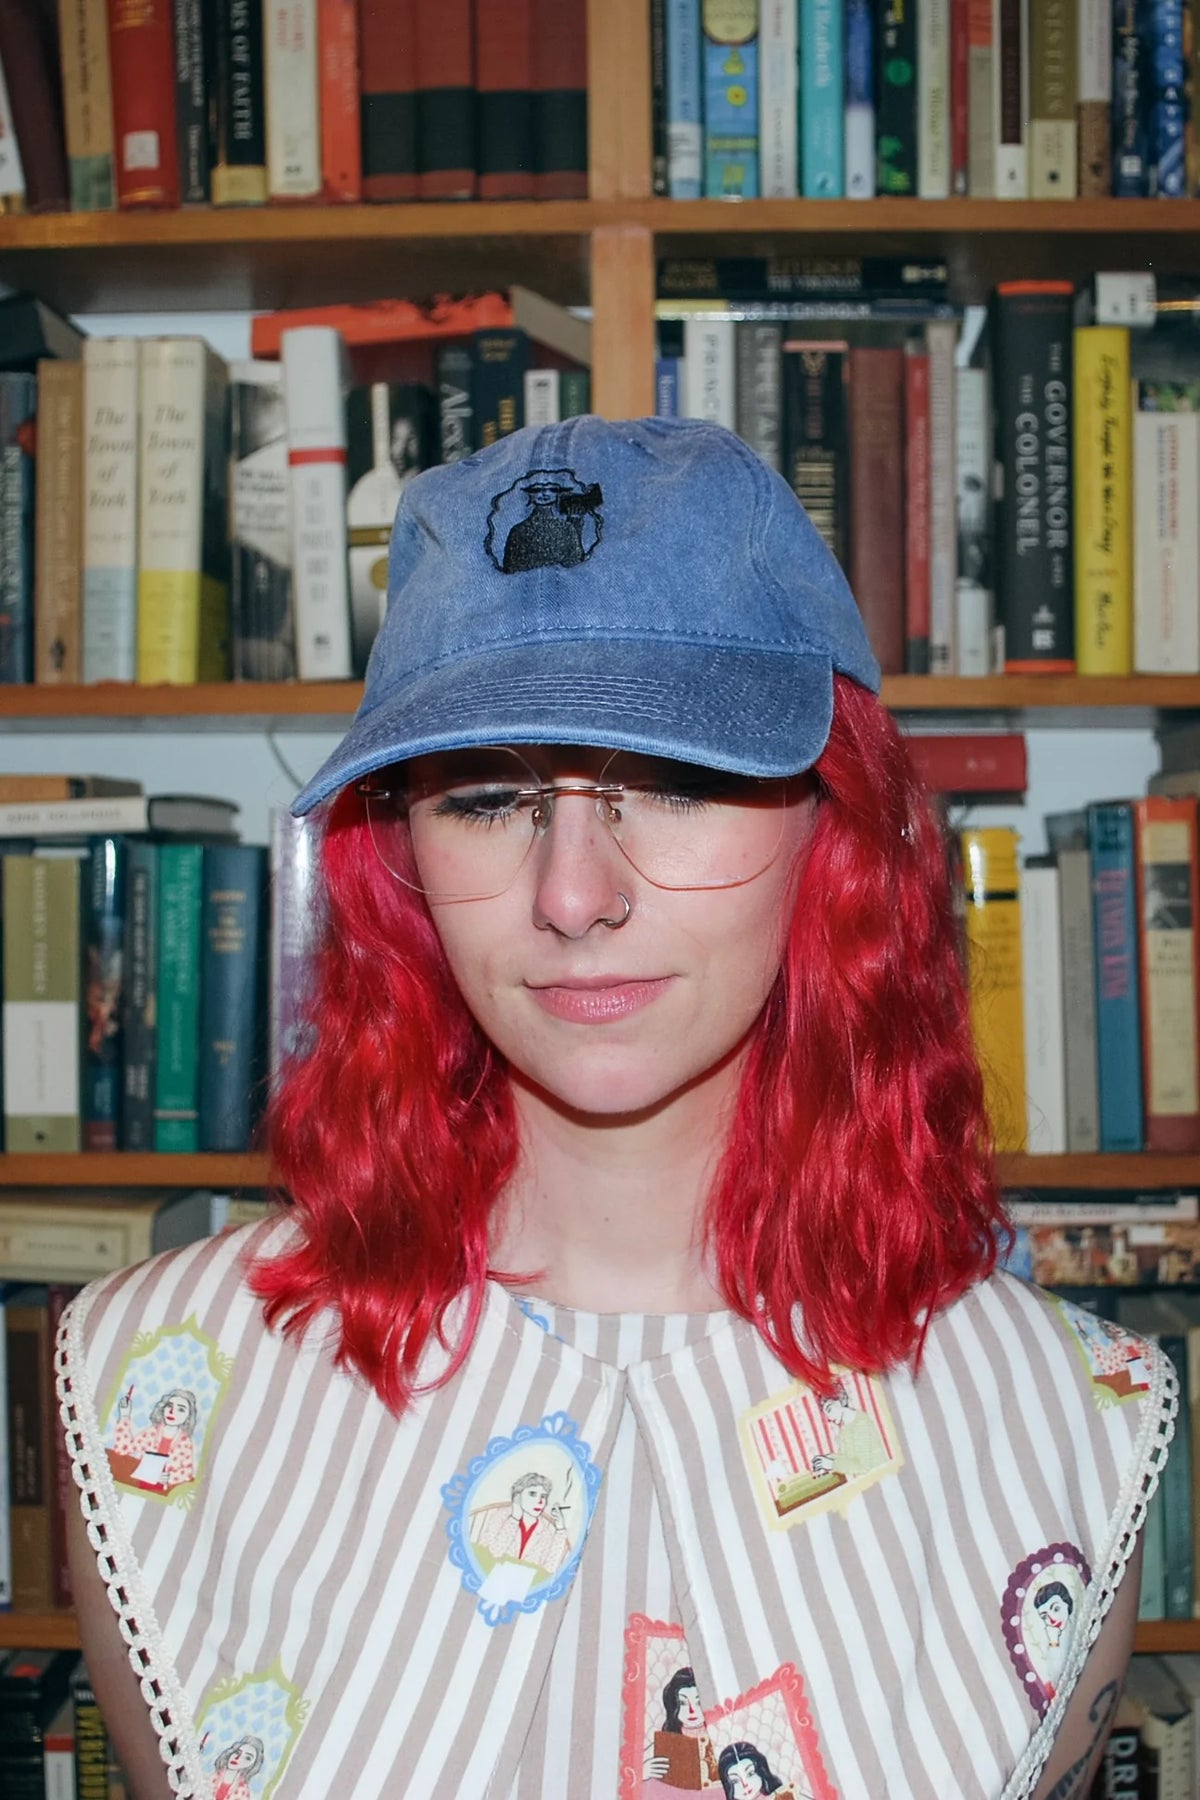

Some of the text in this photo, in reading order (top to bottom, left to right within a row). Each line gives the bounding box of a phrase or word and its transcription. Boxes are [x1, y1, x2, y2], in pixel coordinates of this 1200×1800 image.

[231, 35, 250, 64] OF
[1043, 2, 1065, 112] SISTERS
[233, 72, 252, 139] FAITH
[1015, 413, 1040, 556] COLONEL
[1044, 380, 1068, 548] GOVERNOR
